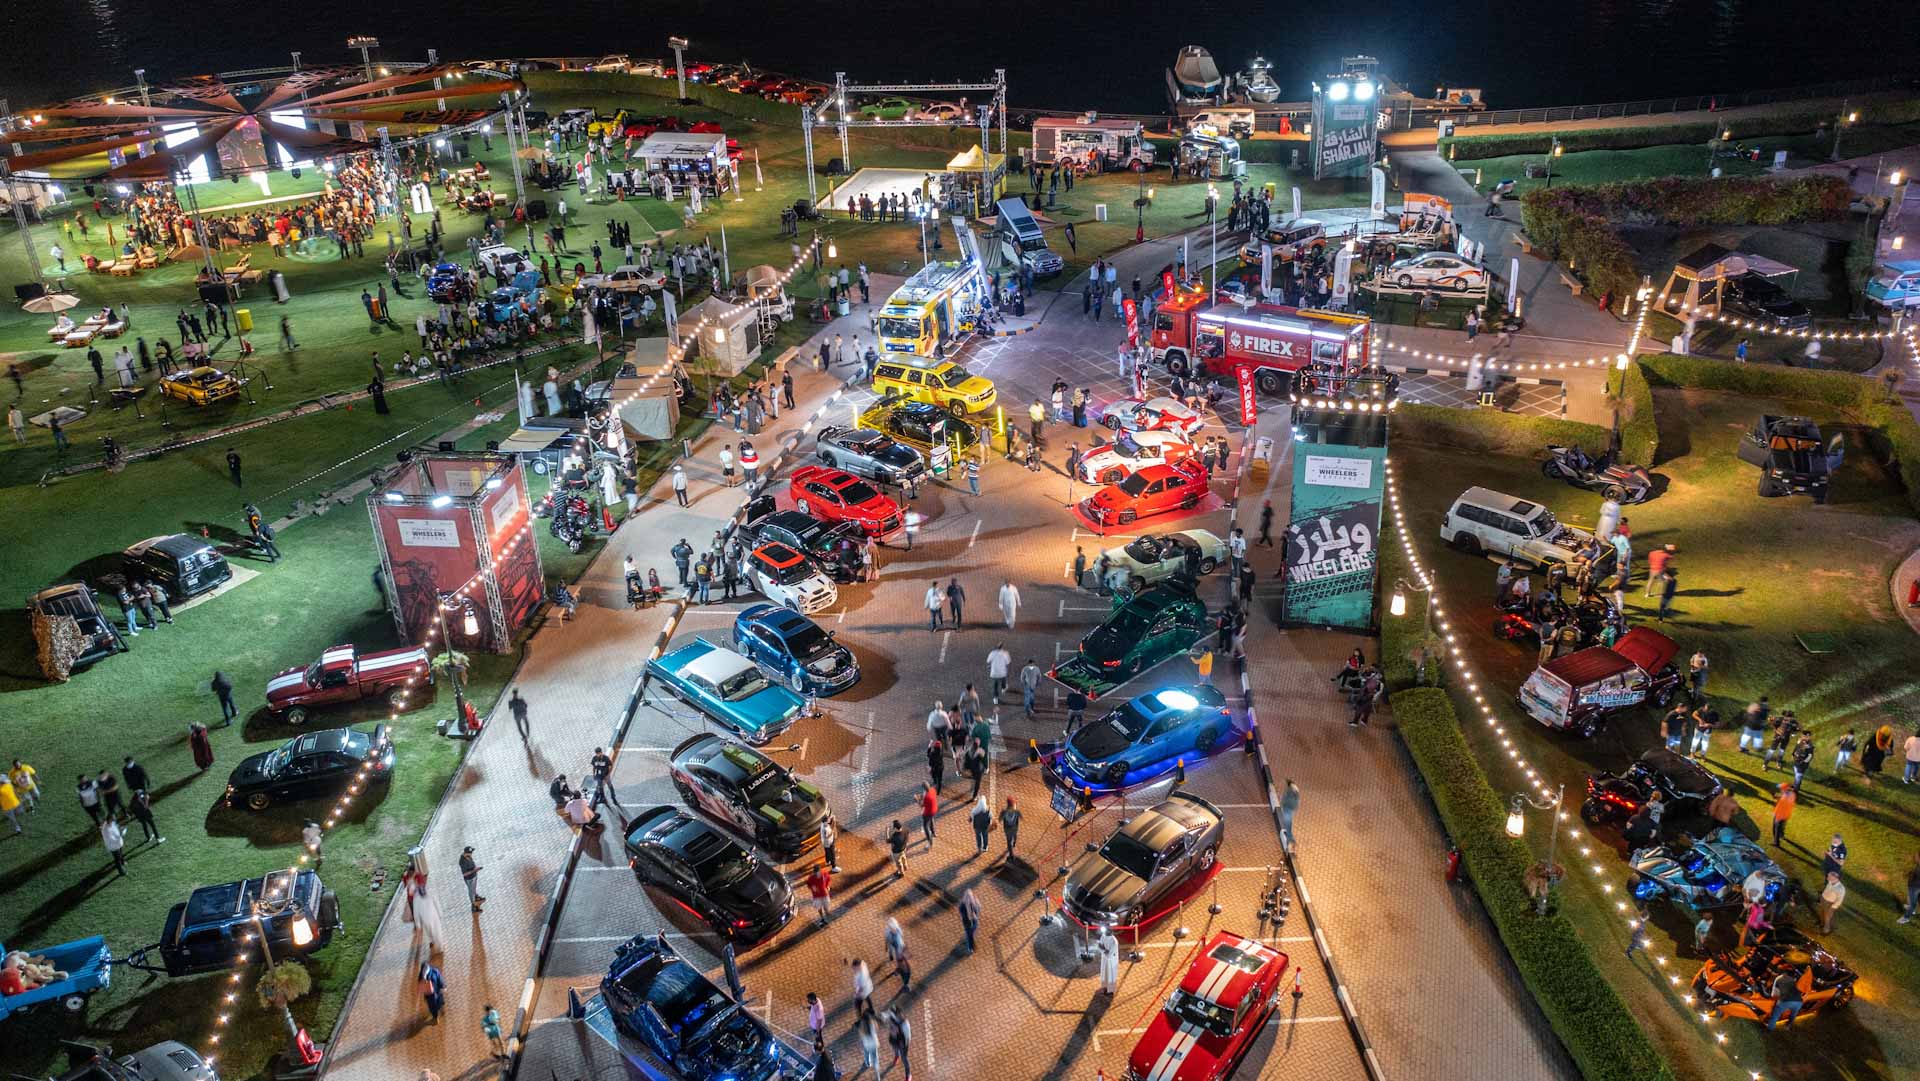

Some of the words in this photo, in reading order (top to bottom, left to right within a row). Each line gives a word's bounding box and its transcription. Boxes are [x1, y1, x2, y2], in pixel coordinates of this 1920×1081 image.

[1324, 122, 1368, 148] الشارقة
[1322, 140, 1372, 165] SHARJAH
[1244, 335, 1293, 357] FIREX
[1319, 469, 1358, 477] WHEELERS
[1290, 516, 1372, 564] ويلرز
[1289, 552, 1372, 583] WHEELERS
